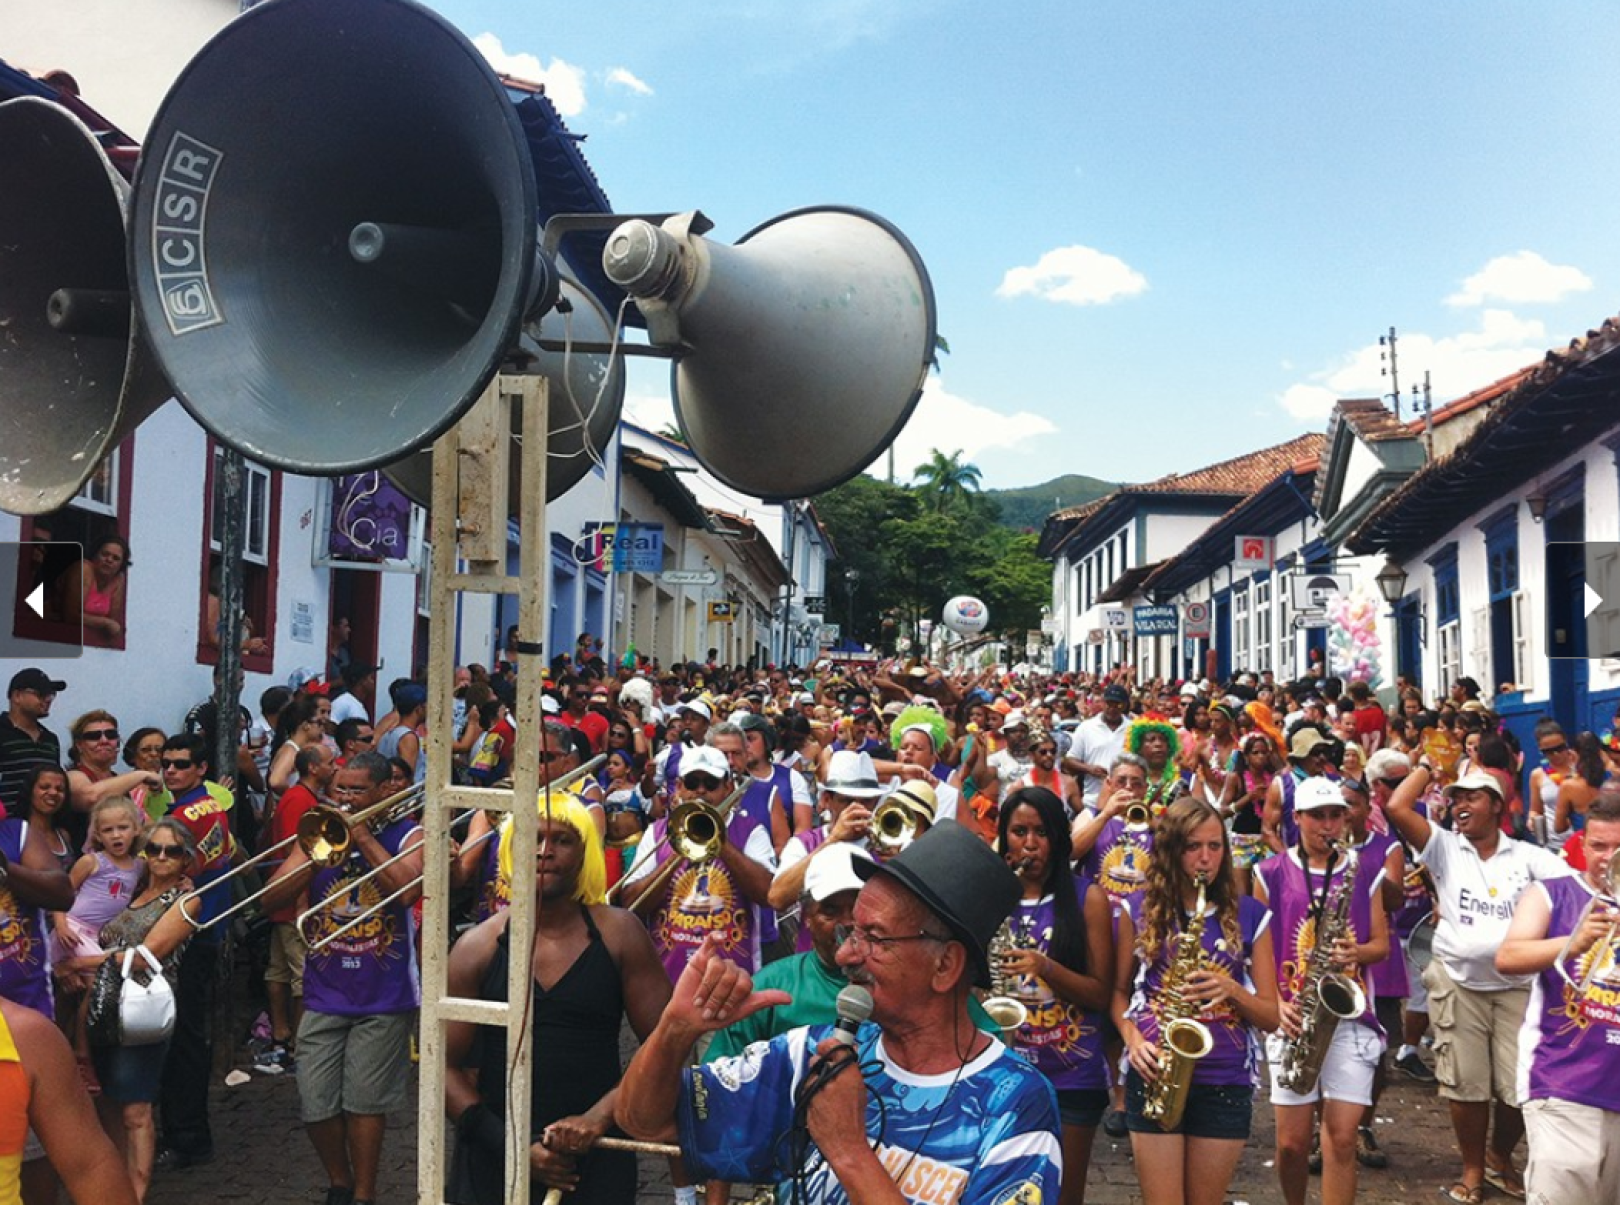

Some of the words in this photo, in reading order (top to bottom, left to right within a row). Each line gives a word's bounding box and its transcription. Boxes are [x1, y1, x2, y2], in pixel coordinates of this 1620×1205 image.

[161, 148, 210, 267] CSR
[350, 516, 398, 549] Cia
[601, 532, 658, 550] Real
